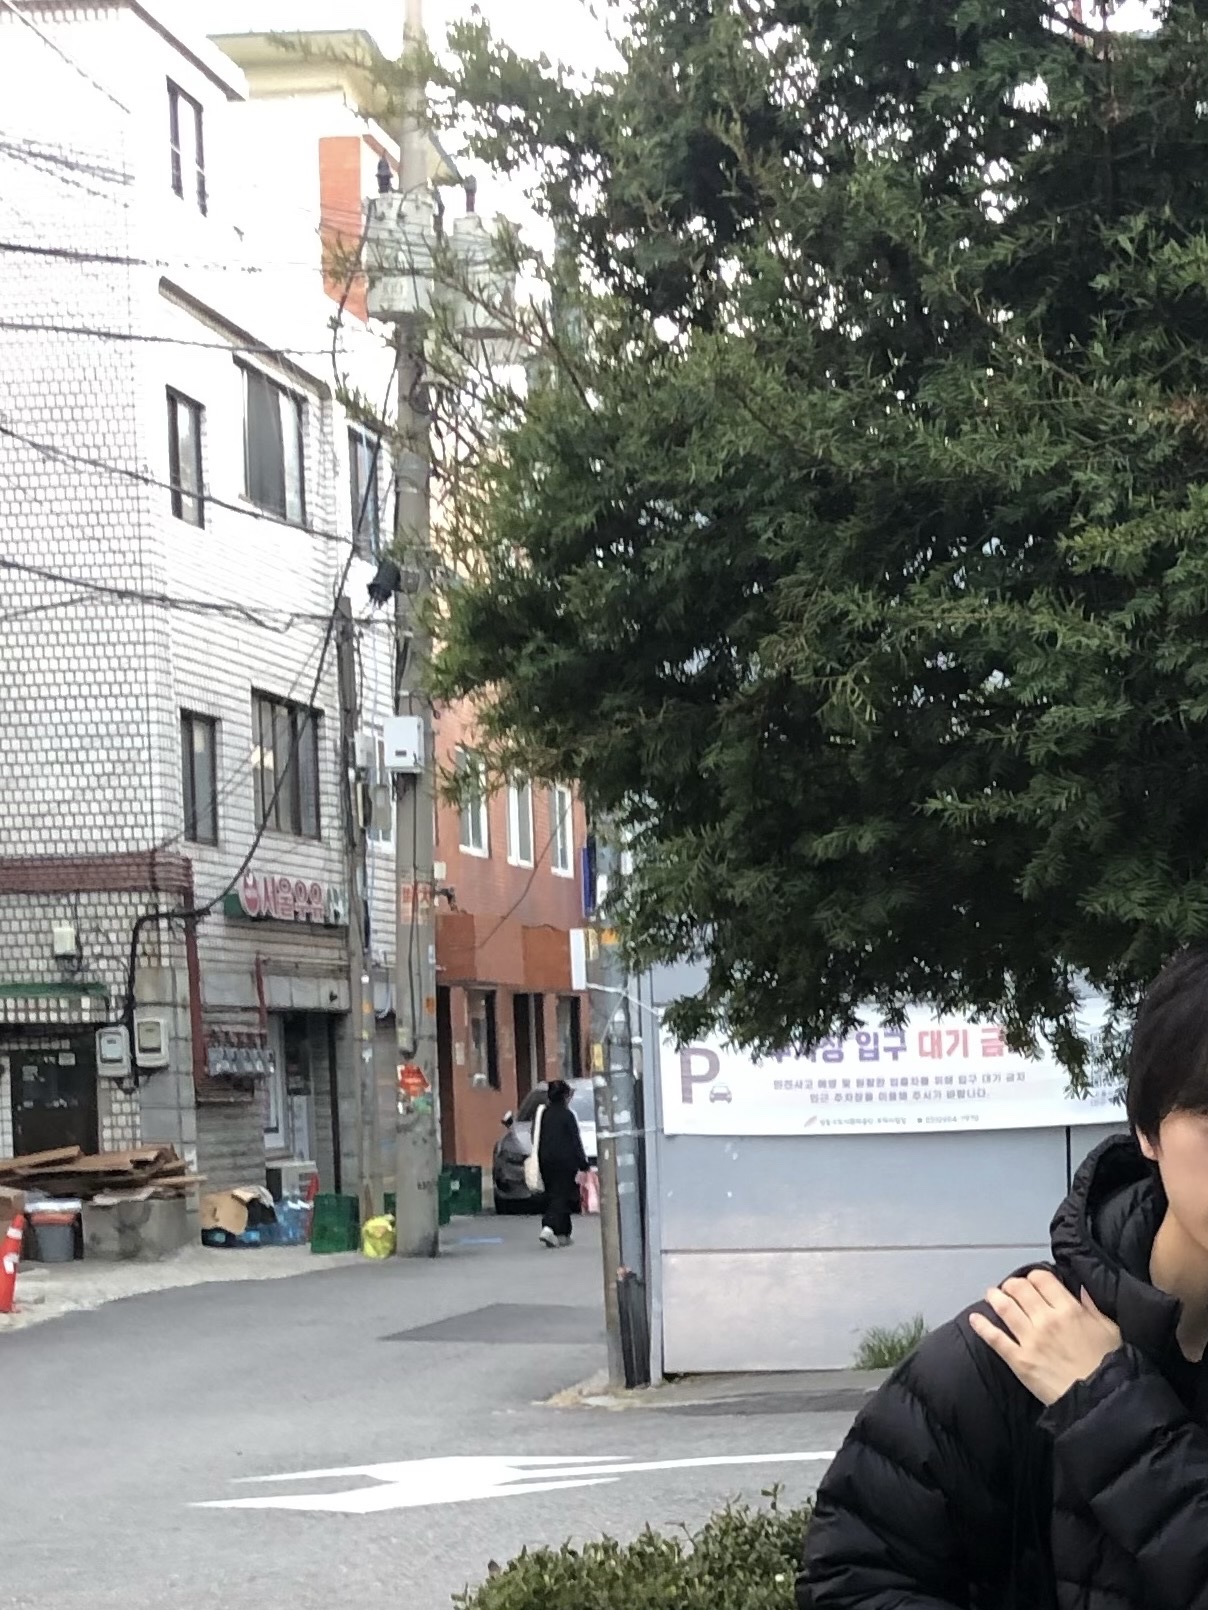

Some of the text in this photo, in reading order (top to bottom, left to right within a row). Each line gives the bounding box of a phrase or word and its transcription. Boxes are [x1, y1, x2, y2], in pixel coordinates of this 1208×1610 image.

[261, 876, 325, 924] 서울우유
[855, 1027, 907, 1061] 입구
[918, 1029, 969, 1060] 대기
[680, 1047, 720, 1104] P
[982, 1073, 1002, 1083] 대기
[1006, 1072, 1026, 1082] 금지
